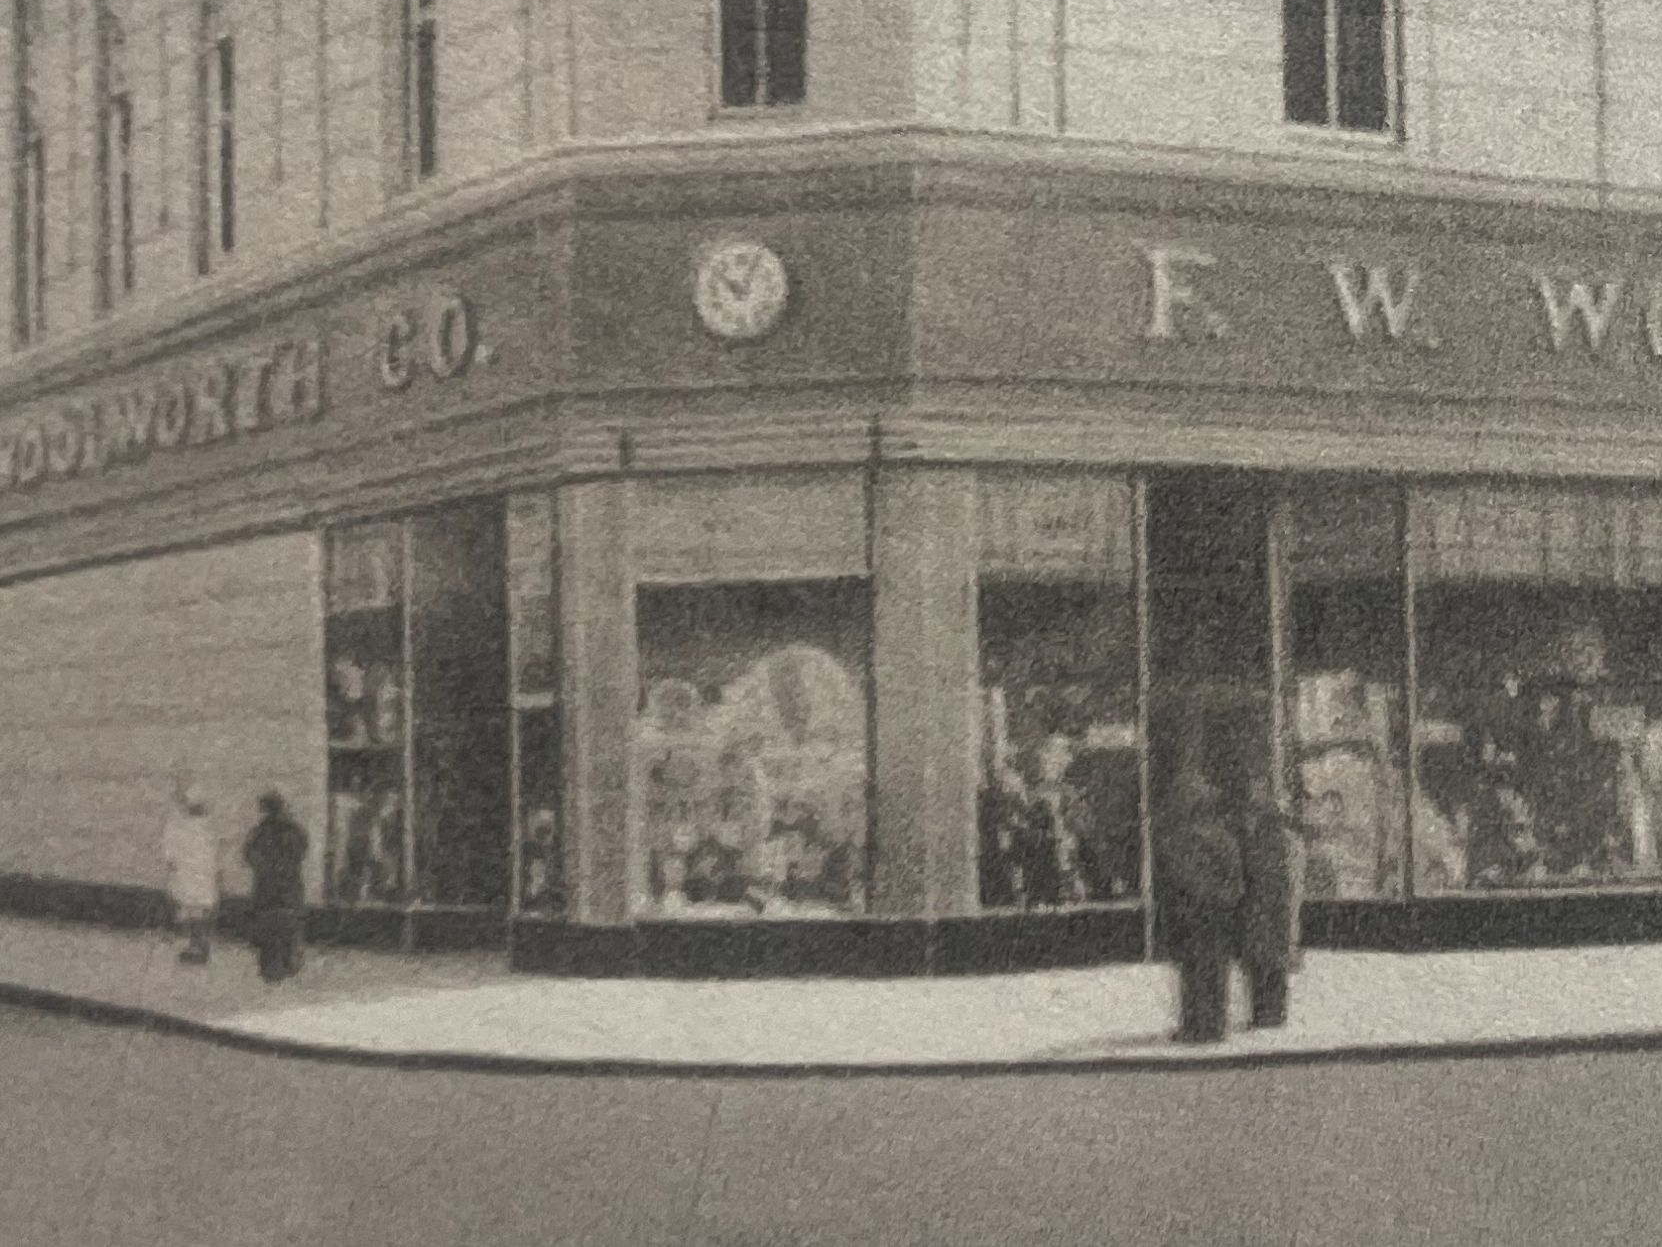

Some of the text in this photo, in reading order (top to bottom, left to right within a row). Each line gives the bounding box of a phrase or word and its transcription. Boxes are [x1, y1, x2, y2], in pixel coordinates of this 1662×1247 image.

[1325, 253, 1443, 350] W.
[0, 291, 494, 485] OOLWORTH CO.
